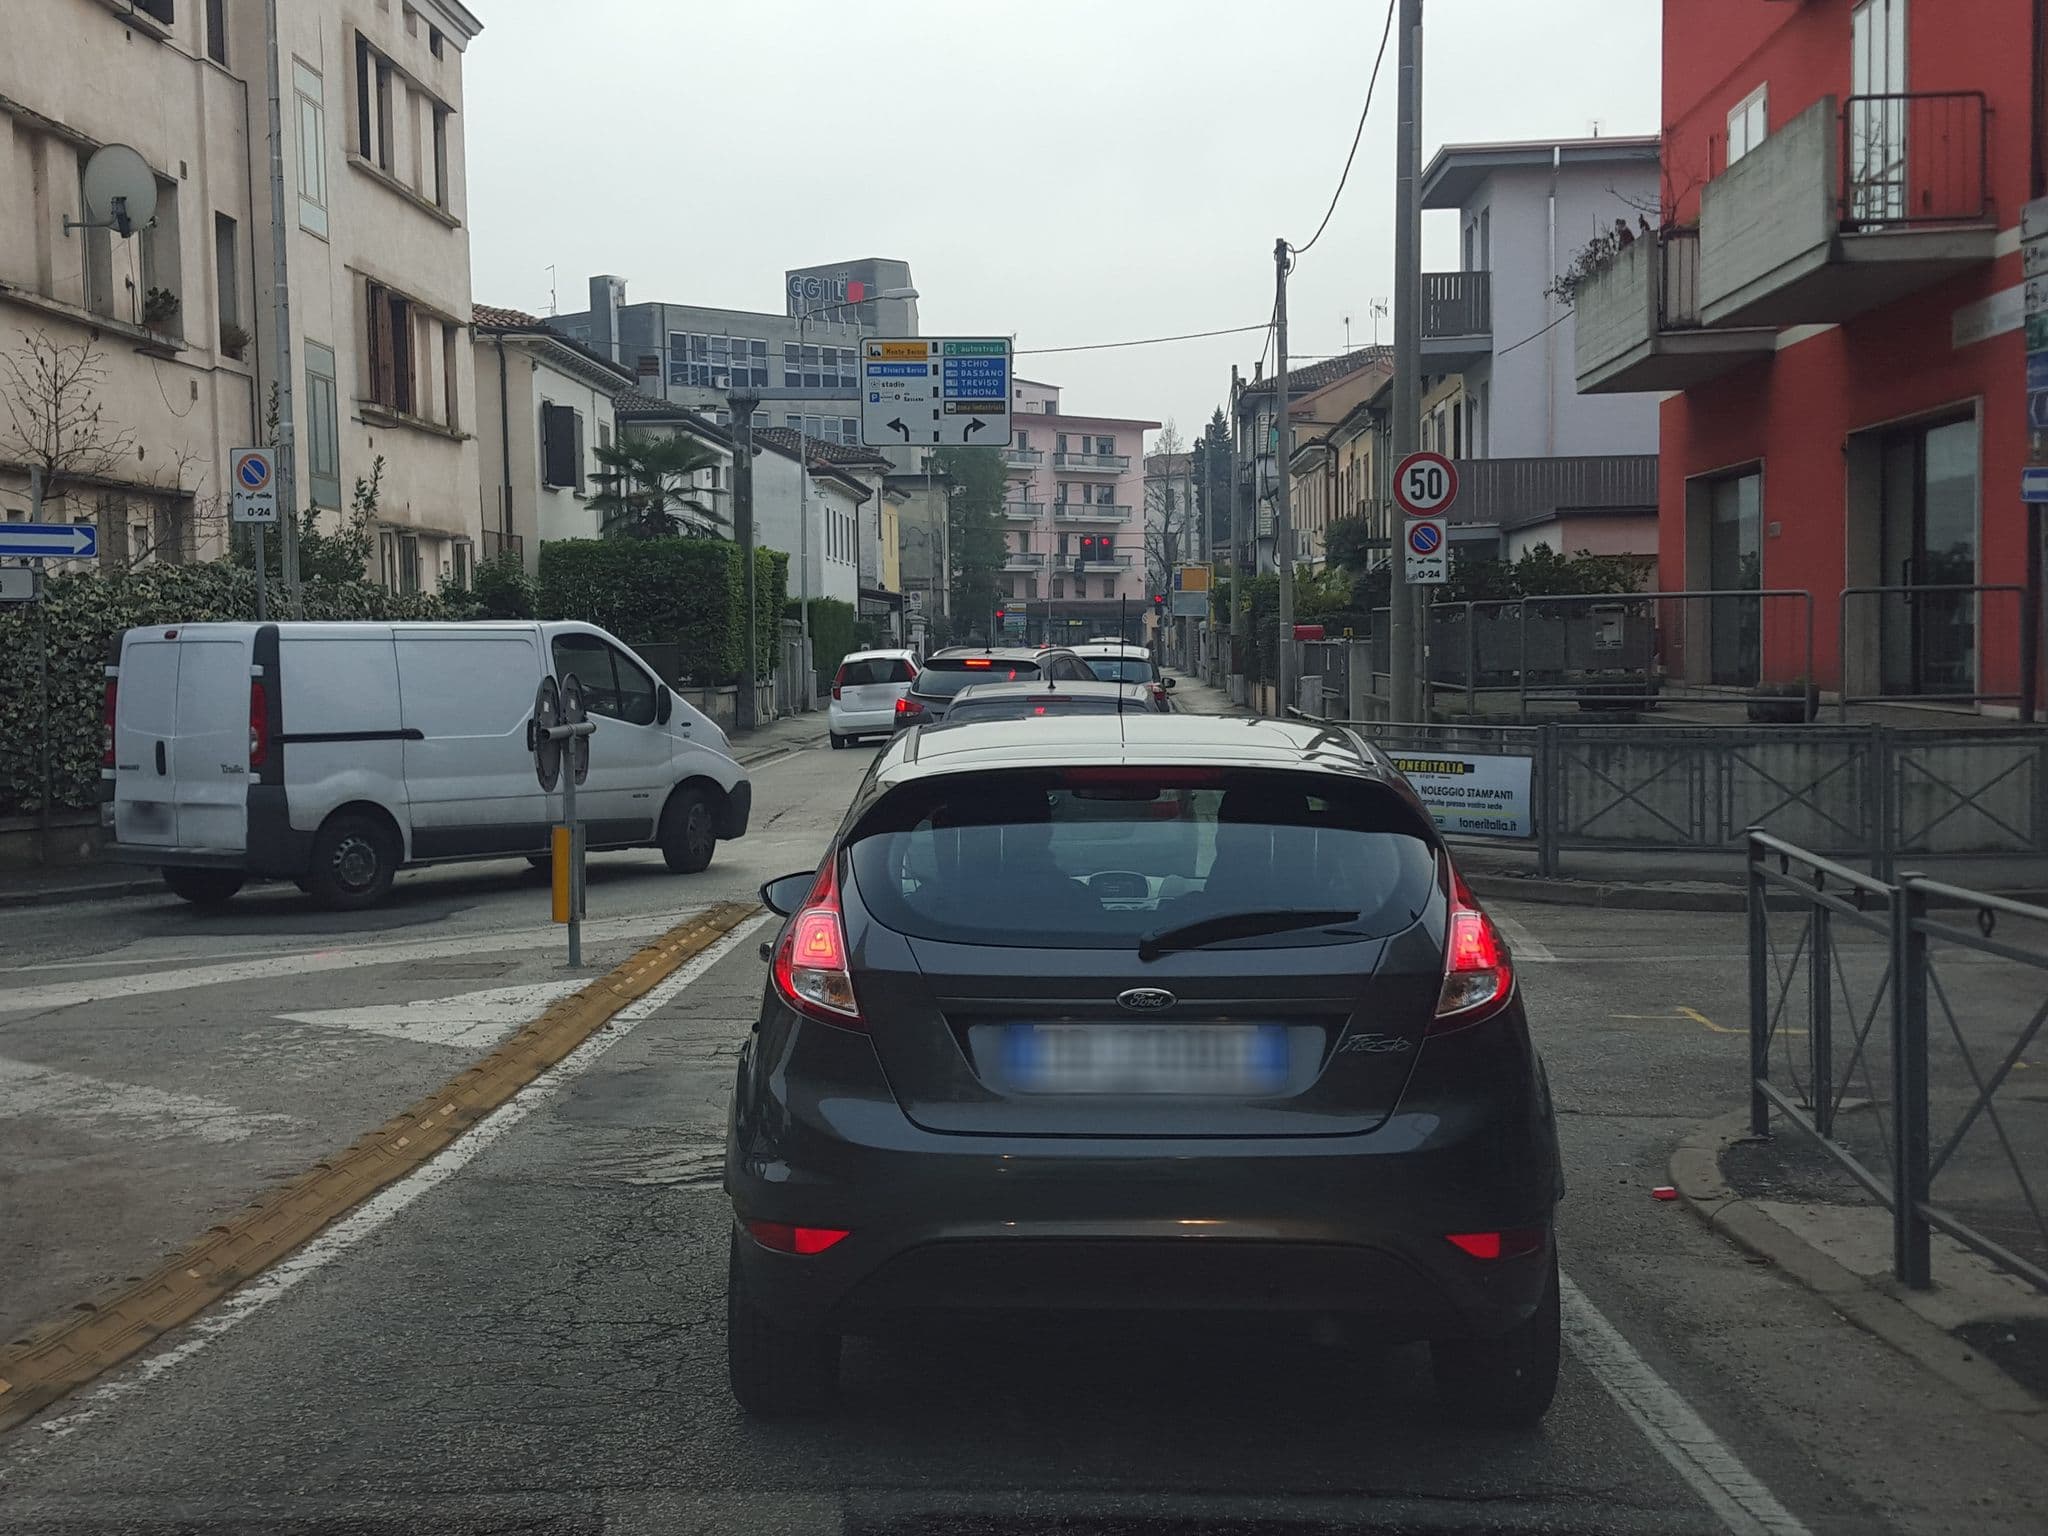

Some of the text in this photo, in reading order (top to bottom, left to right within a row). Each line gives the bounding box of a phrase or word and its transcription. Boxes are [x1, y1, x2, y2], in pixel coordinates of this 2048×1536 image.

[960, 344, 1004, 352] autostrada
[1410, 468, 1442, 500] 50
[248, 508, 270, 516] 0-24
[1418, 570, 1440, 578] 0-24
[1421, 786, 1513, 800] NOLEGGIO STAMPANTI
[1460, 817, 1517, 832] toneritalia.it
[1130, 992, 1163, 1006] Ford
[1339, 1033, 1412, 1052] Fiesta
